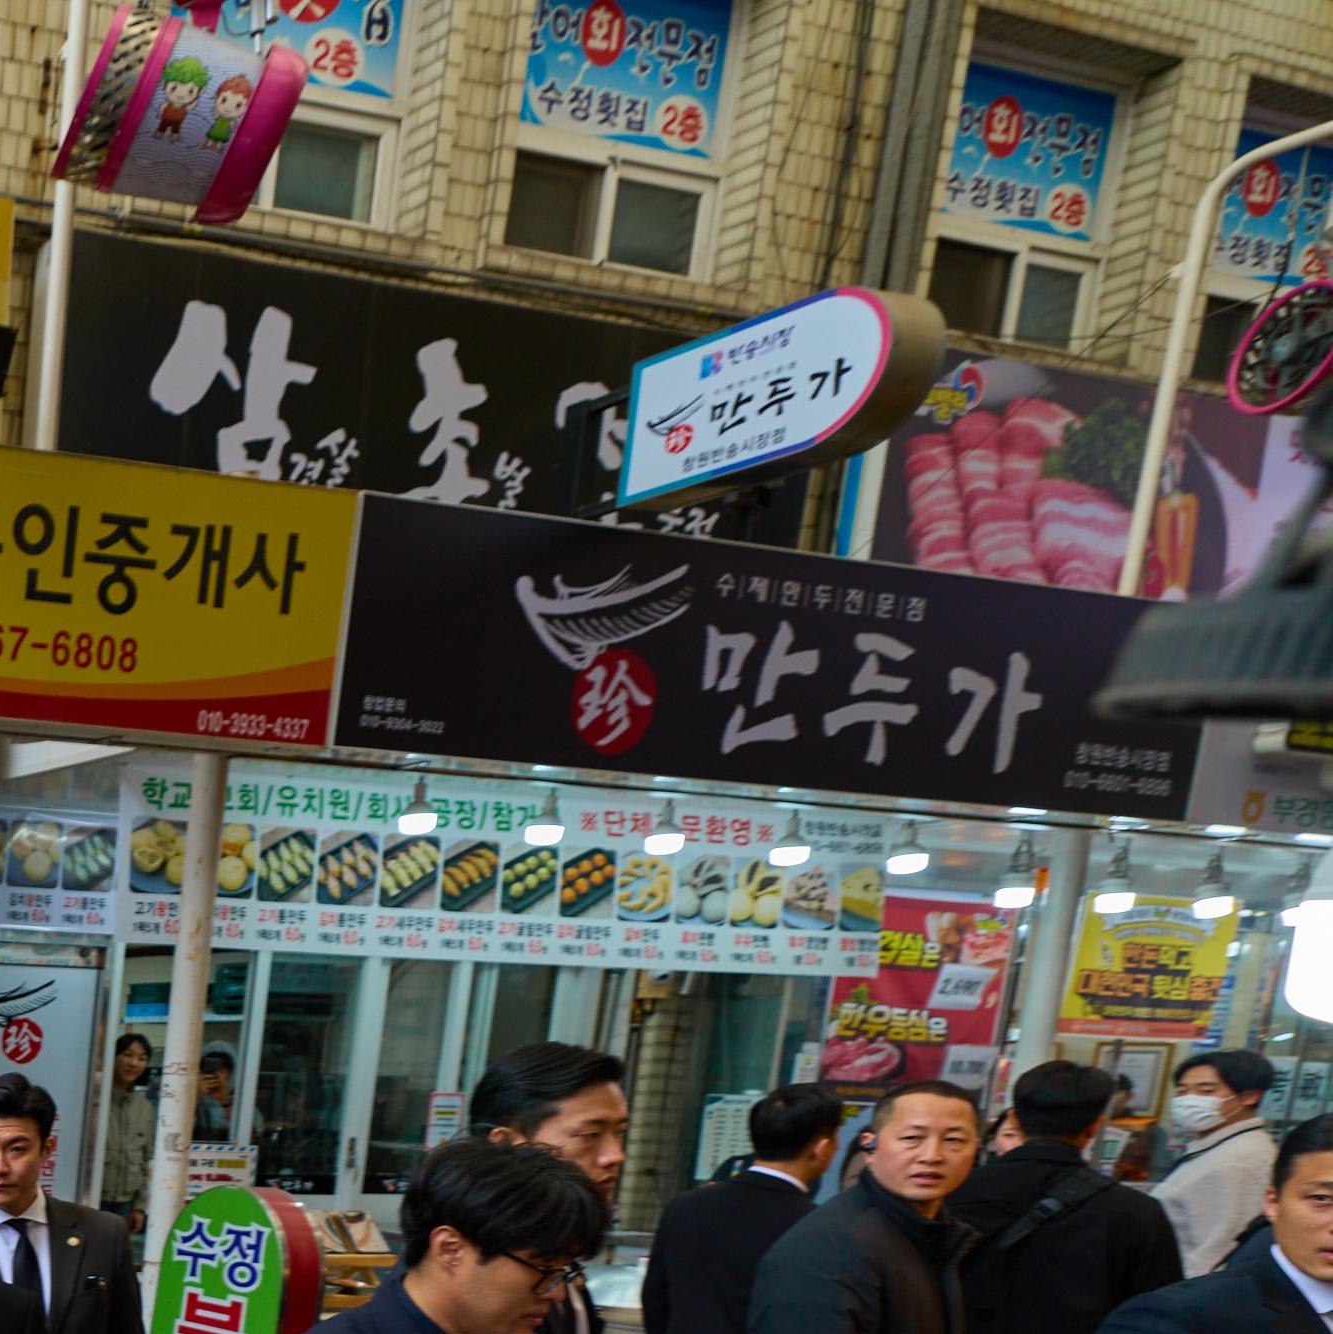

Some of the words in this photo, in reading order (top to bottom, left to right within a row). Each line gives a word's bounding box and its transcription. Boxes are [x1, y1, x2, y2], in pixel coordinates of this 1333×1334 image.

[312, 38, 357, 79] 2층
[538, 80, 648, 133] 수정횟집
[660, 104, 704, 143] 2층
[946, 170, 1039, 217] 수정횟집
[1049, 191, 1086, 227] 2층
[709, 357, 853, 437] 만두가
[702, 621, 1045, 775] 만두가
[196, 708, 311, 741] 010-3933-4337
[174, 1215, 271, 1292] 수정
